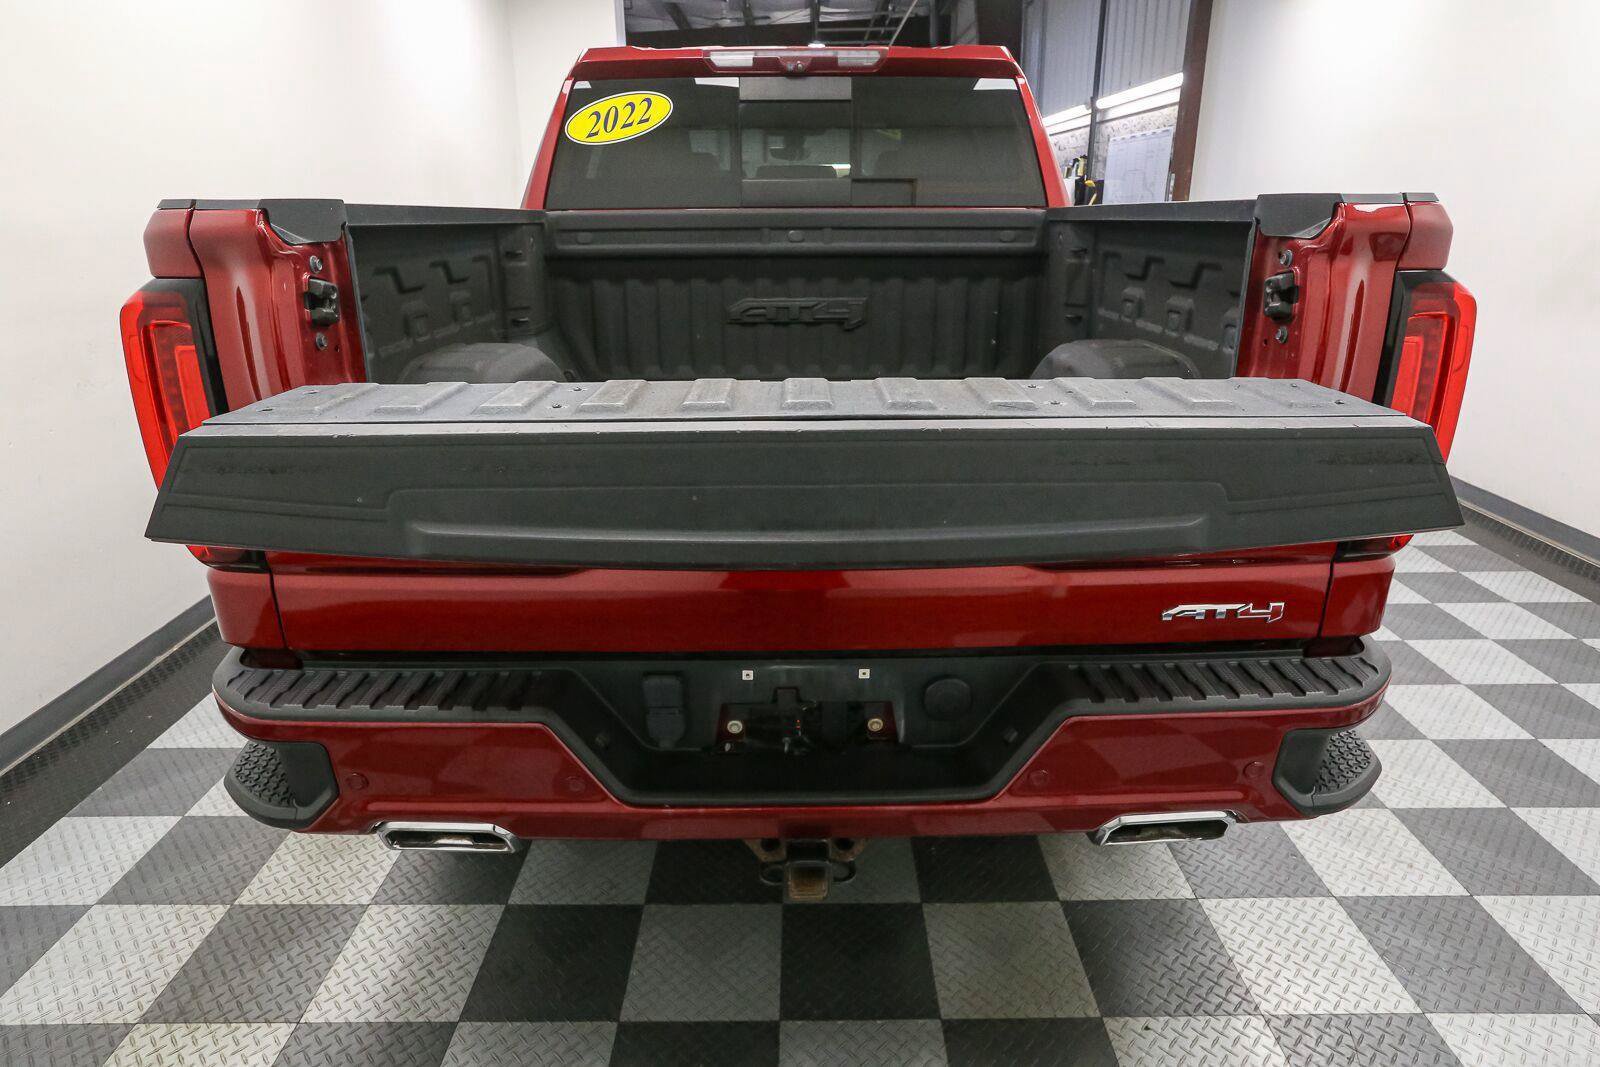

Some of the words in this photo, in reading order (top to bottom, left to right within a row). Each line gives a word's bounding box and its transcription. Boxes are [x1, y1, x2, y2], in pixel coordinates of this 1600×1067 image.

[586, 97, 653, 138] 2022
[728, 298, 867, 332] AT4
[1162, 602, 1285, 623] AT4
